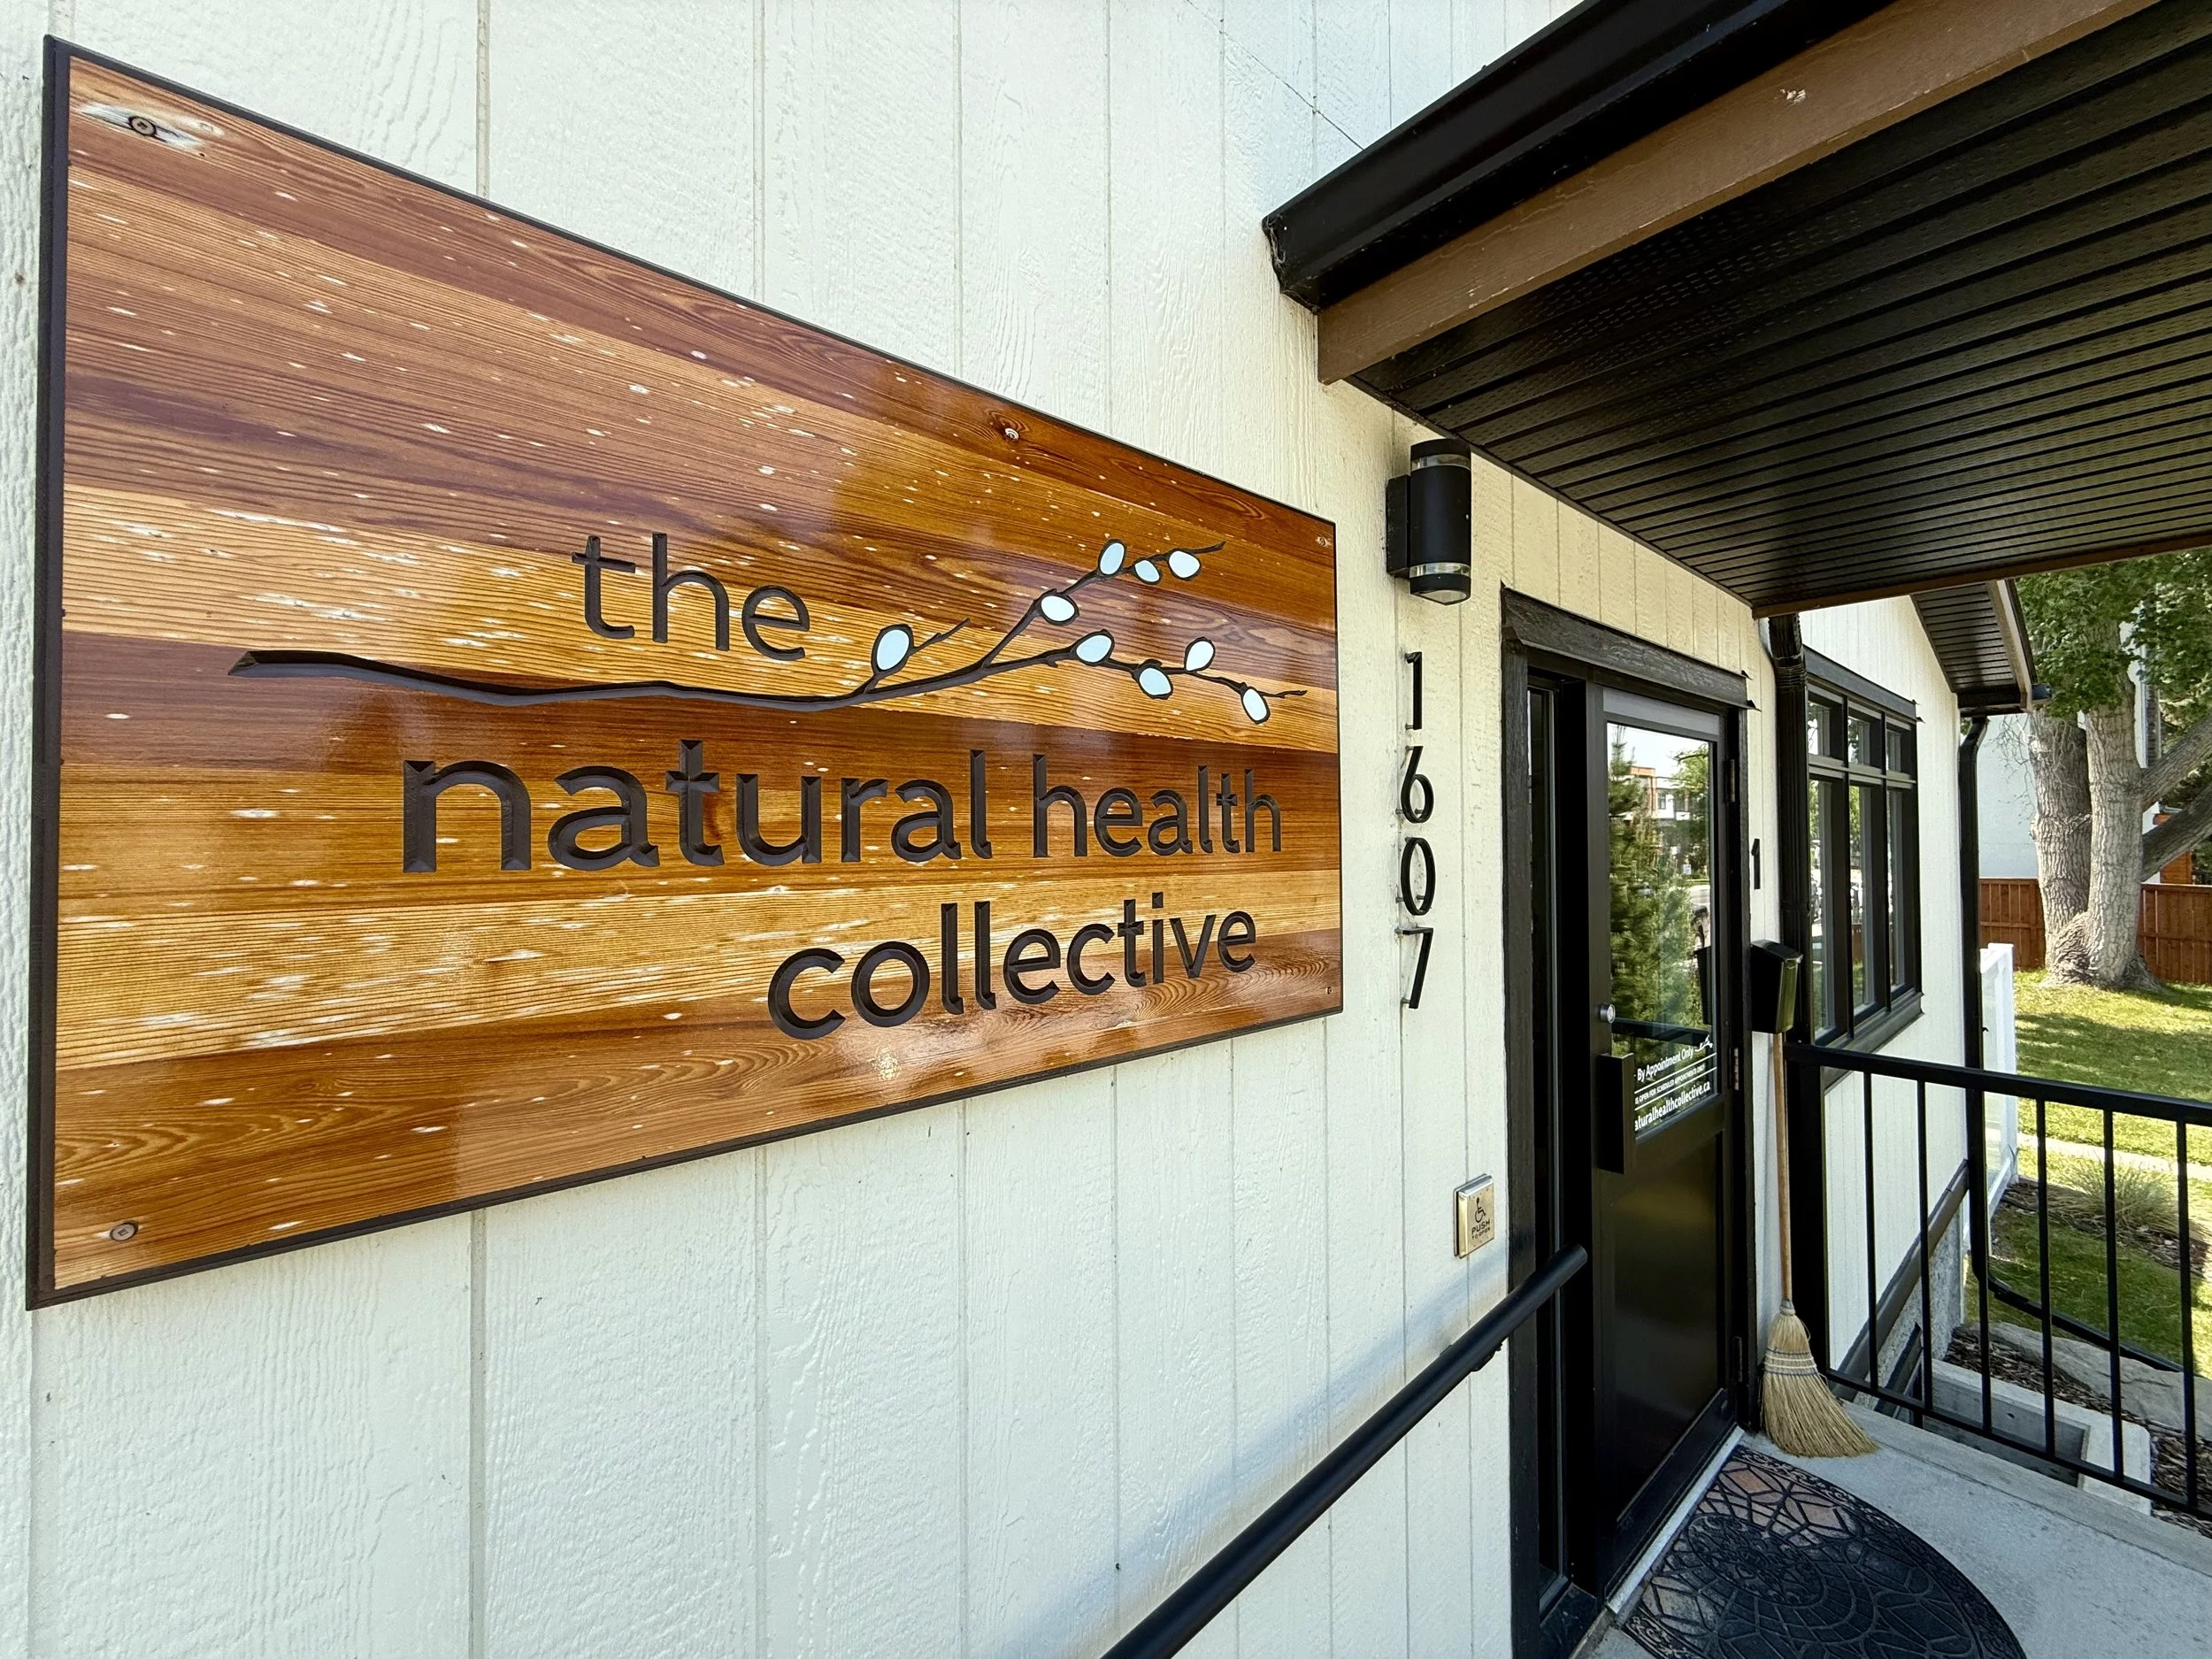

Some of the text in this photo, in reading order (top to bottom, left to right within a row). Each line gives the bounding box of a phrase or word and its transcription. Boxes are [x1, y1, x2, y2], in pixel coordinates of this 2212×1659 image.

[572, 532, 810, 661] the
[403, 740, 1282, 872] natural health
[1400, 651, 1436, 1009] 1607
[768, 892, 1257, 1040] collective
[1634, 1081, 1710, 1131] aturalhealthcollective.ca
[1637, 1047, 1694, 1081] By Appointment Only
[1471, 1217, 1490, 1235] PUSH
